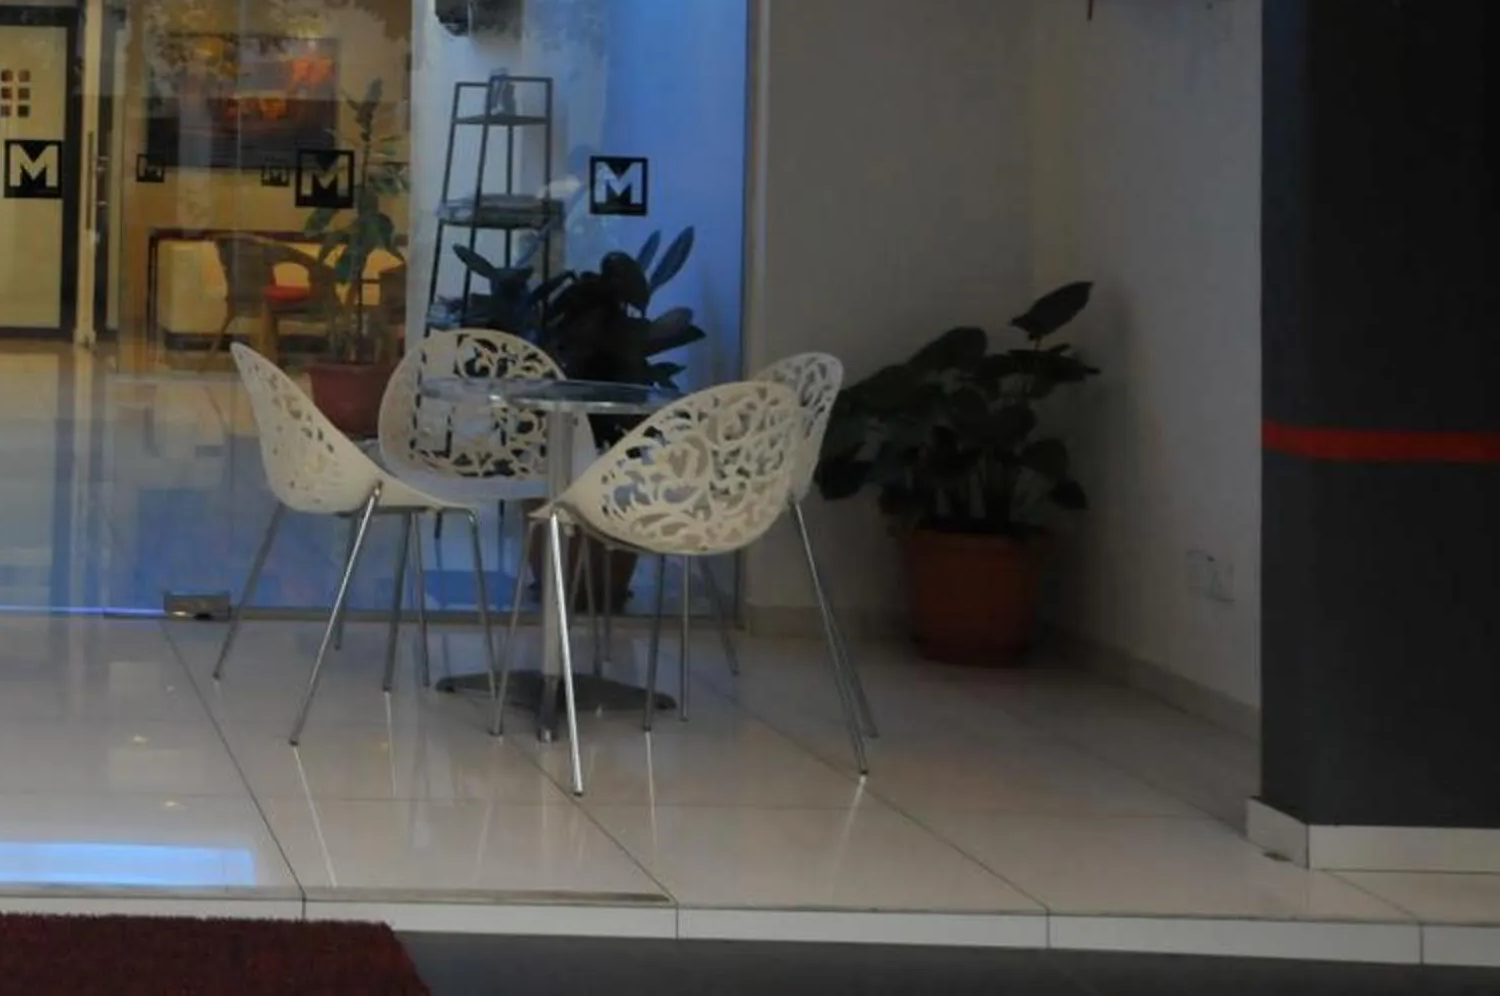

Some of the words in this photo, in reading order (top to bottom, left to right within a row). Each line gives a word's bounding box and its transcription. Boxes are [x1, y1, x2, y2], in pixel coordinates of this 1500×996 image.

[9, 144, 58, 187] M
[300, 153, 350, 196] M
[595, 161, 643, 204] M
